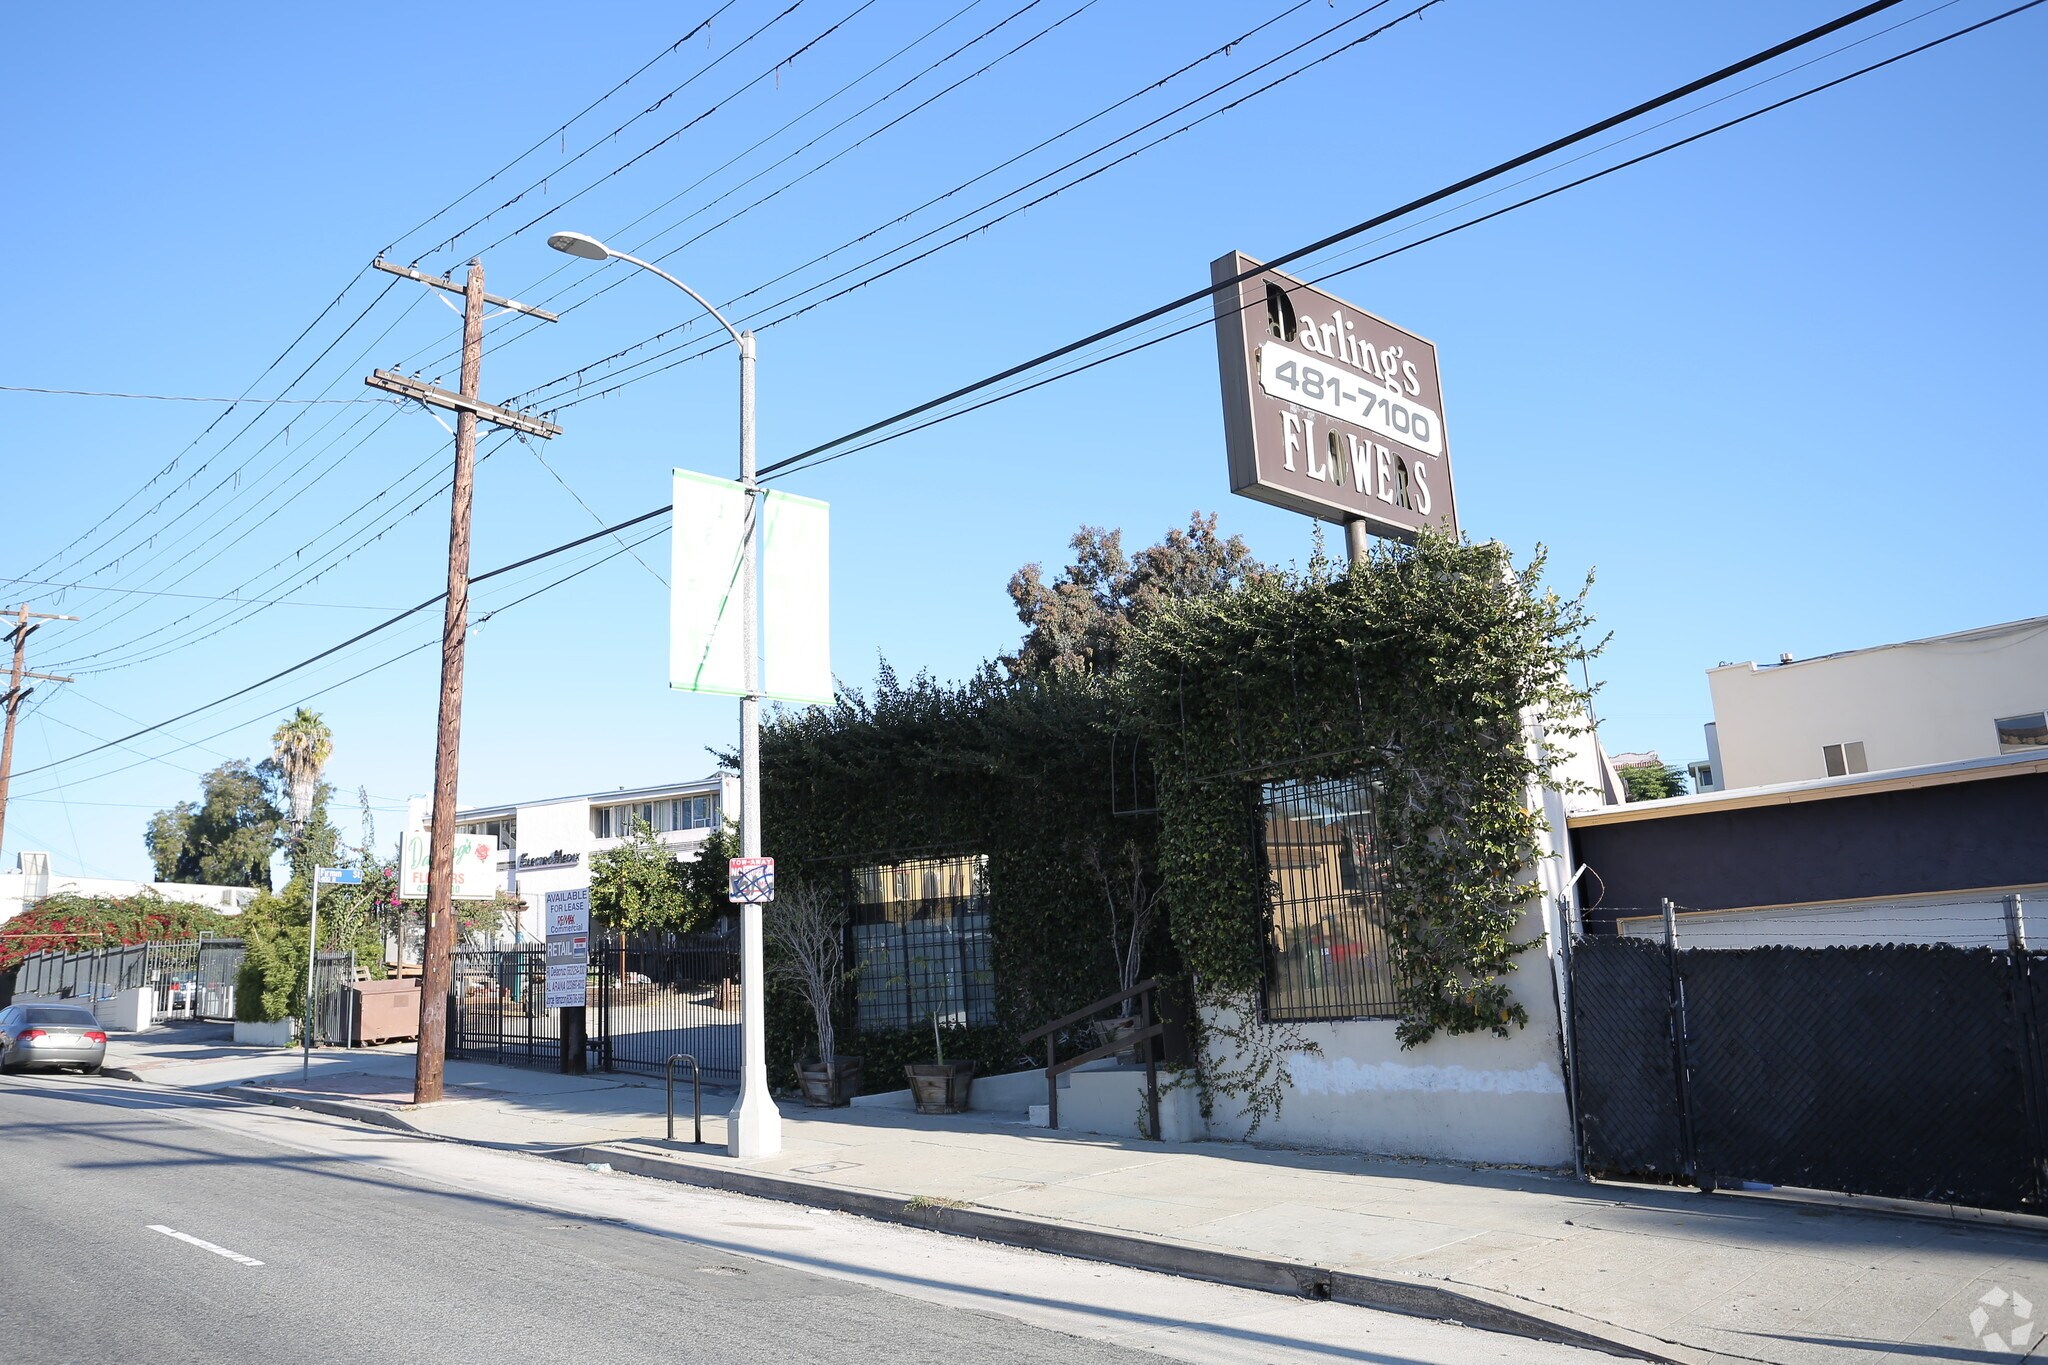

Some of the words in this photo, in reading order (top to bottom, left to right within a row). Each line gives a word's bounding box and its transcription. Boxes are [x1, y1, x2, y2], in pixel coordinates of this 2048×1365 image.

[1262, 278, 1421, 398] Darling's
[1275, 360, 1430, 443] 481-7100
[1279, 409, 1432, 517] FLOWERS
[352, 870, 361, 879] St
[412, 872, 465, 884] FLRS
[546, 890, 587, 903] AVAILABLE
[550, 904, 563, 914] FOR
[564, 902, 584, 912] LEASE
[550, 923, 583, 934] Commercial
[547, 940, 573, 958] RETAIL
